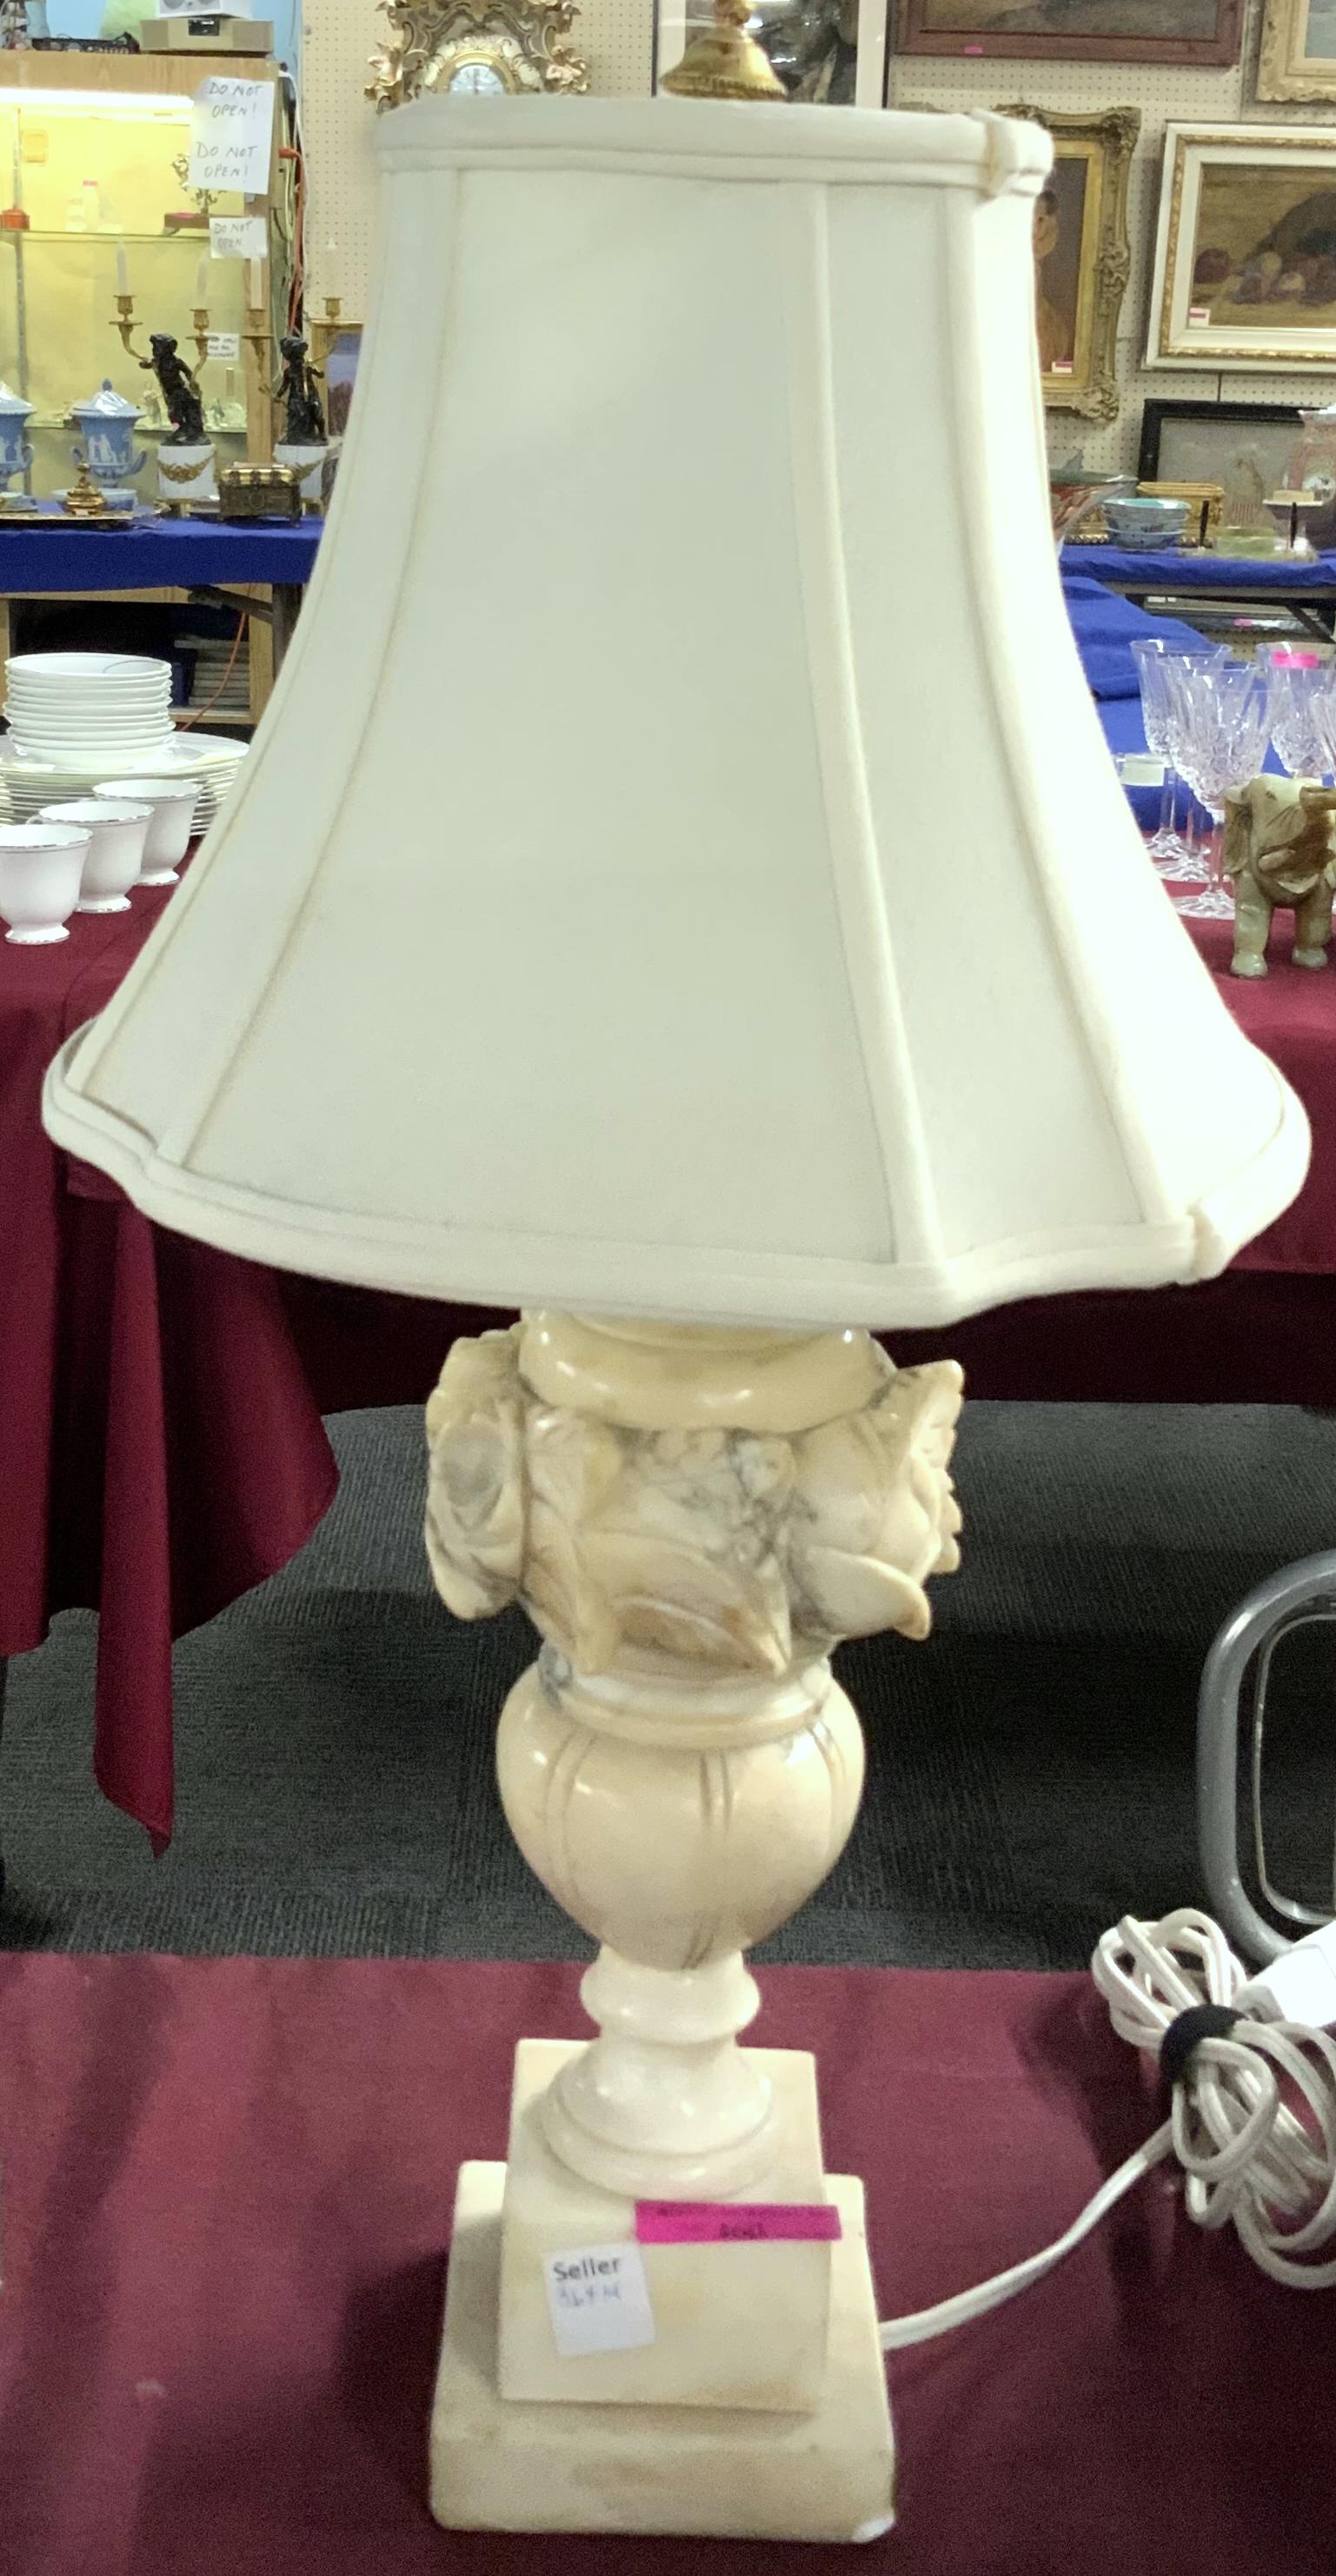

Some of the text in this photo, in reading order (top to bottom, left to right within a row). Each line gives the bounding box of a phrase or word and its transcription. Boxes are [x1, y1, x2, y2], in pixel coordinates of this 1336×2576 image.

[209, 82, 263, 97] DO NOT
[196, 141, 258, 158] DO NOT
[214, 221, 253, 235] DO NOT
[553, 2257, 621, 2281] Seller
